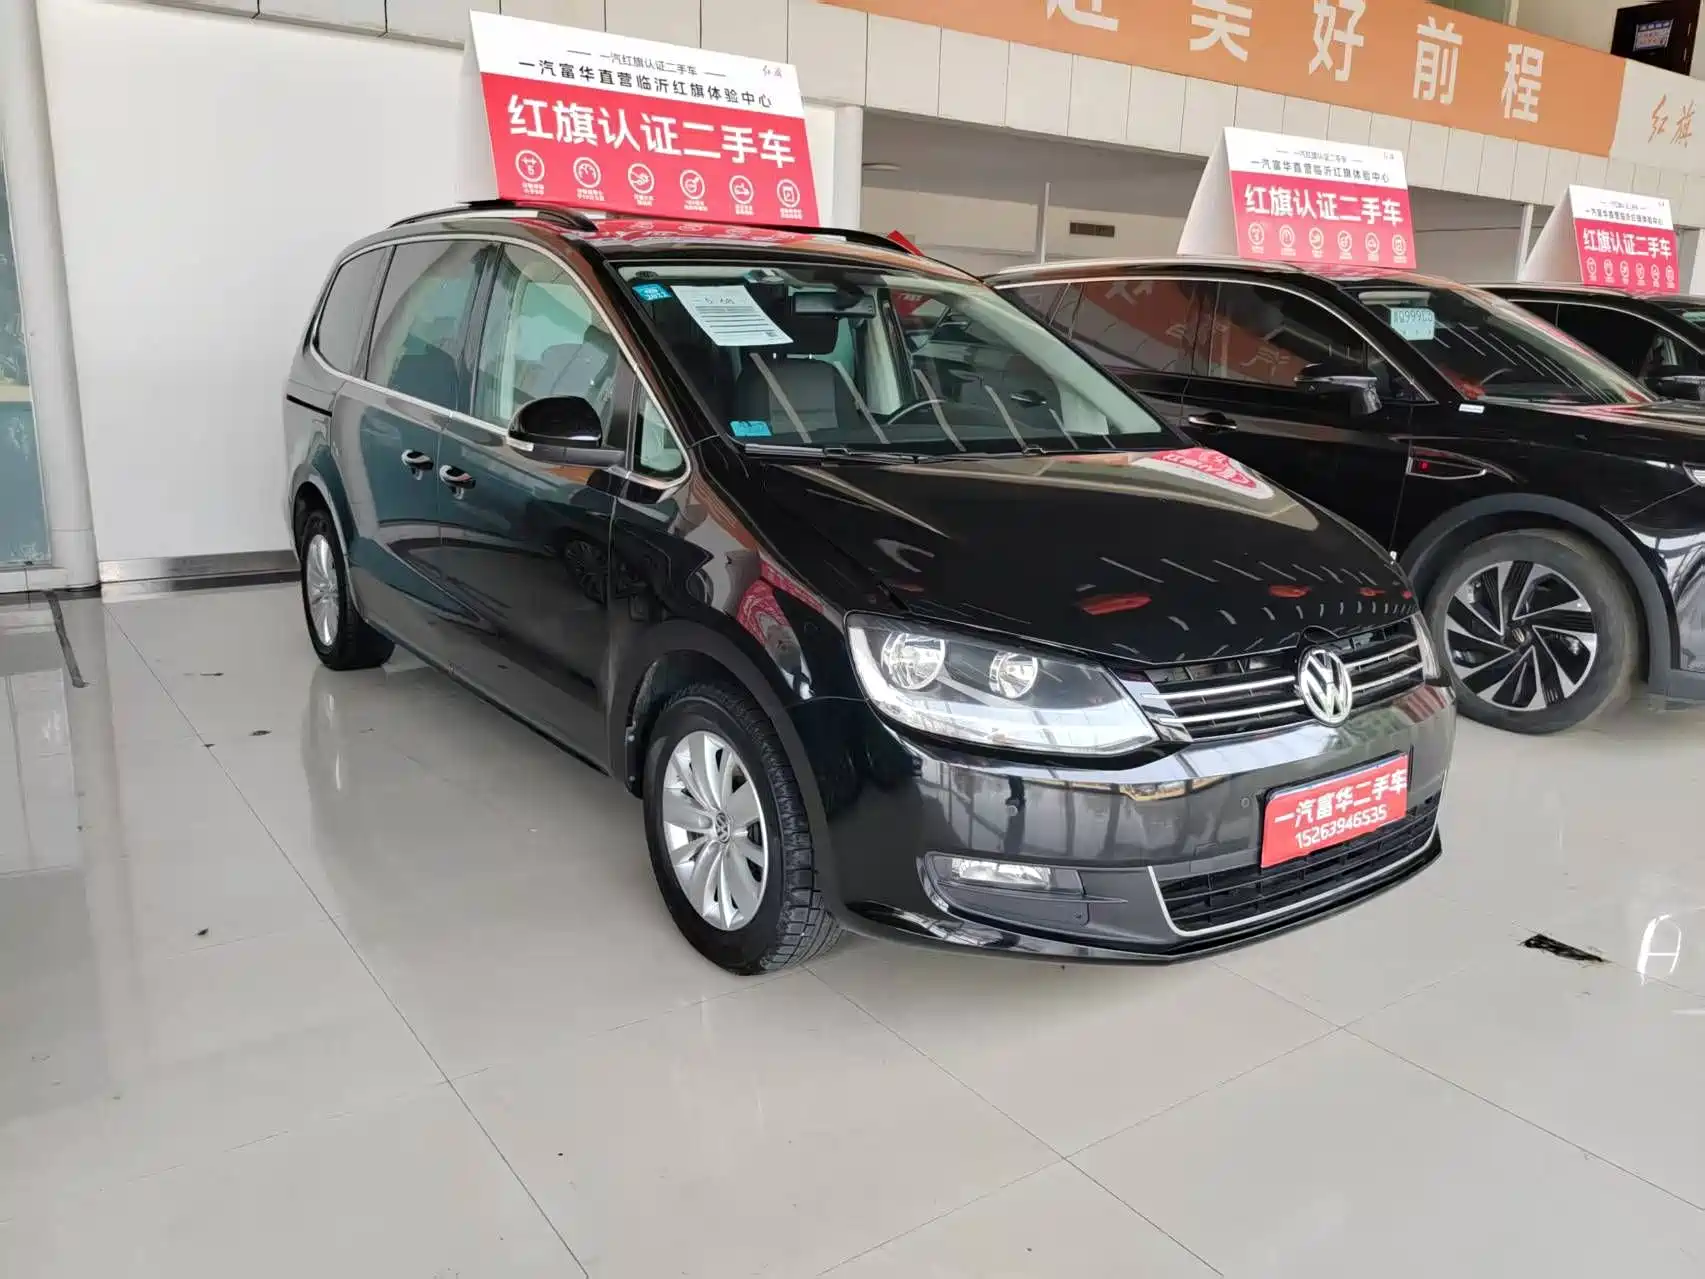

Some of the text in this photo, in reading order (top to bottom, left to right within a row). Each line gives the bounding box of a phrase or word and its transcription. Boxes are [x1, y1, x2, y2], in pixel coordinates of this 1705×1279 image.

[518, 59, 772, 108] 一汽富华直营临沂红旗体验中心
[507, 94, 797, 169] 红旗认证二手车
[1244, 184, 1404, 228] 红旗认证二手车
[1583, 227, 1673, 261] 红旗认证二手车
[1274, 768, 1407, 828] 一汽富华二手车
[1295, 804, 1388, 848] 15263946535
